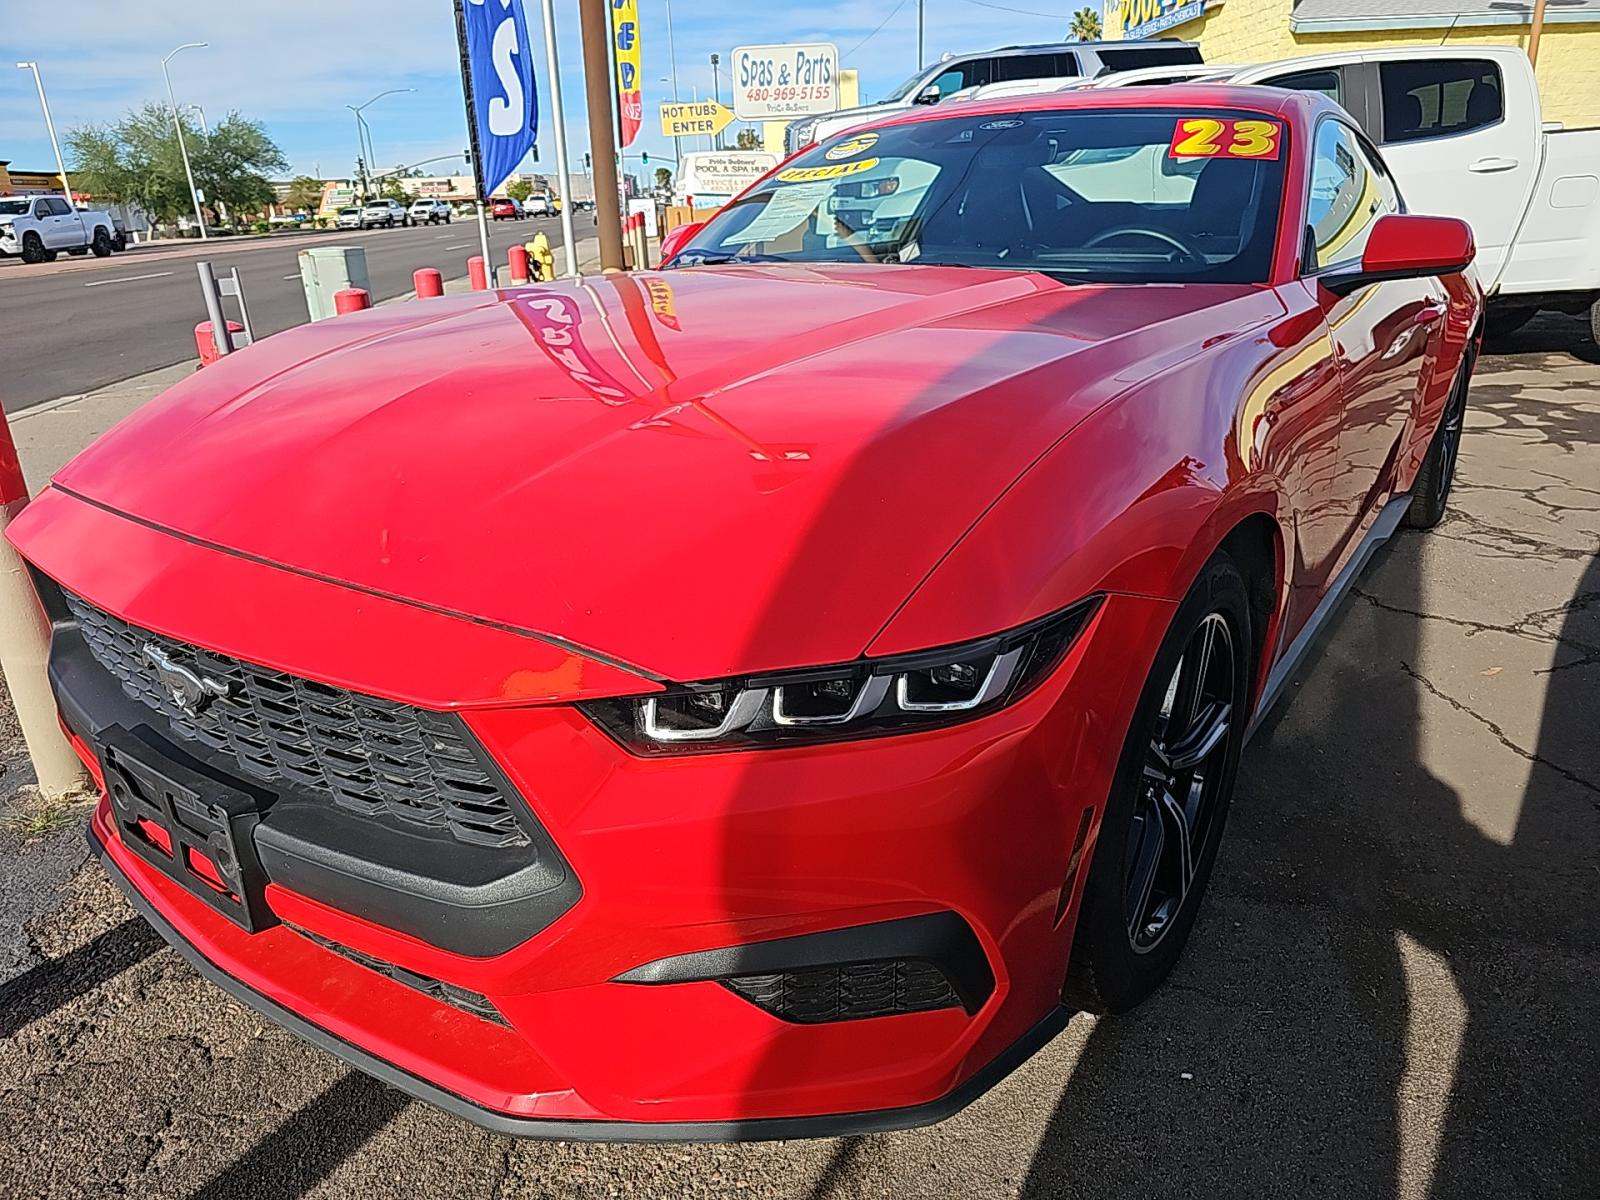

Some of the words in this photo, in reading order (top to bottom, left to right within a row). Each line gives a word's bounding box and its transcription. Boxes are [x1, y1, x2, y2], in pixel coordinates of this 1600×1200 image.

[740, 52, 773, 87] Spas
[778, 63, 791, 86] &
[795, 51, 831, 85] Parts
[746, 86, 831, 102] 480-969-5155
[662, 106, 684, 119] HOT
[687, 104, 718, 117] TUBS
[672, 119, 714, 133] ENTER
[695, 165, 721, 173] POOL
[731, 165, 749, 173] SPA
[781, 162, 861, 179] SPECIAL
